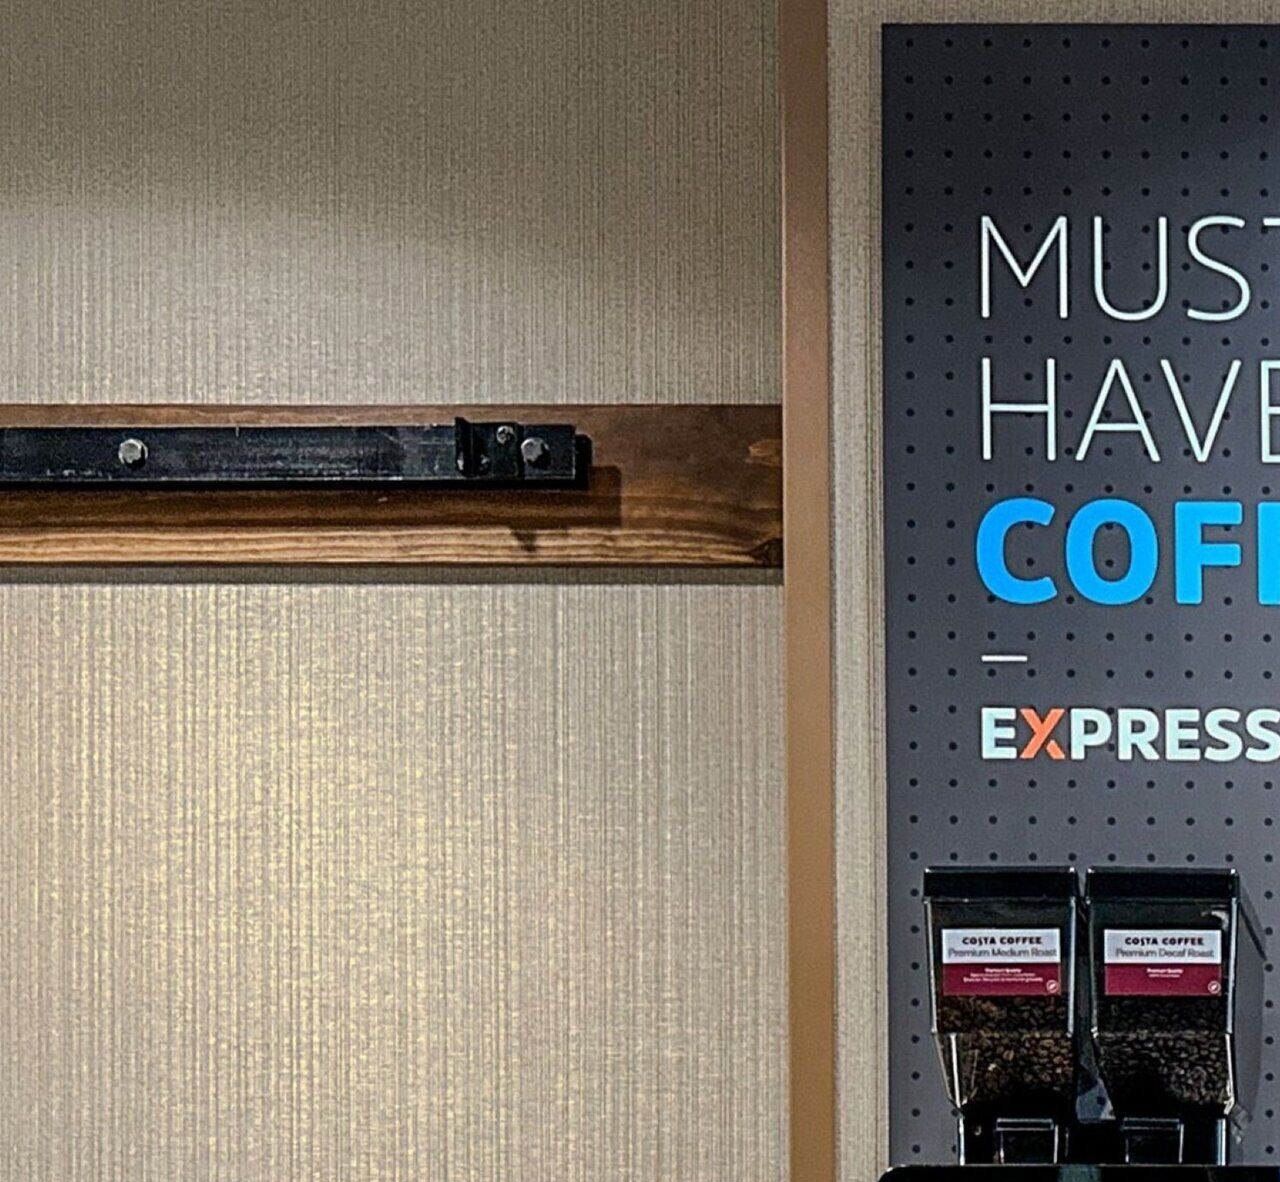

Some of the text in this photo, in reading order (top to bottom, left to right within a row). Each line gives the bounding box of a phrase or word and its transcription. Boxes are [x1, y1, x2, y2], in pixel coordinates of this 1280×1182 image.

[962, 936, 1042, 946] COSTA COFFEE
[1124, 937, 1204, 946] COSTA COFFEE
